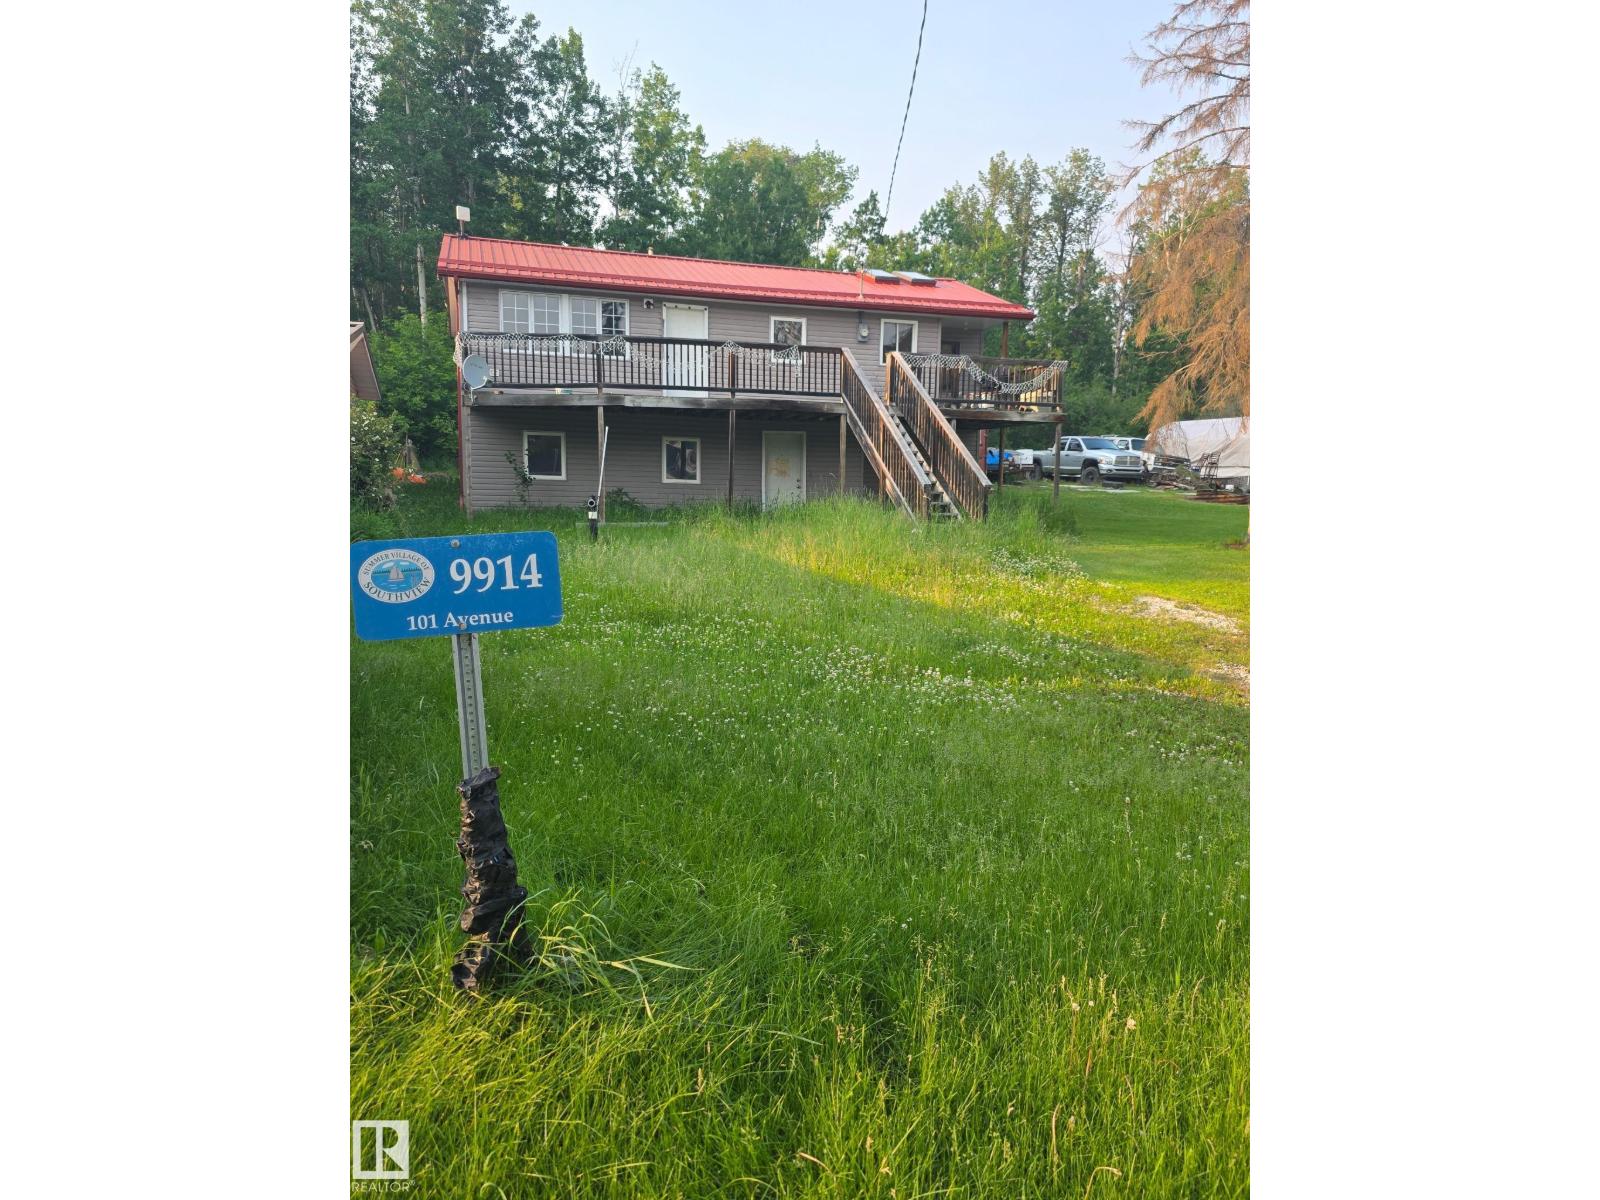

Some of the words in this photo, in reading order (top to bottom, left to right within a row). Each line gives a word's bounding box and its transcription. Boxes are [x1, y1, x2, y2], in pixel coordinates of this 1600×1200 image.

[363, 553, 390, 576] SUMMER
[390, 552, 422, 563] VILLAGE
[450, 553, 543, 594] 9914
[364, 576, 431, 601] SOUTHVIEW
[407, 613, 438, 631] 101
[443, 611, 514, 628] Avenue
